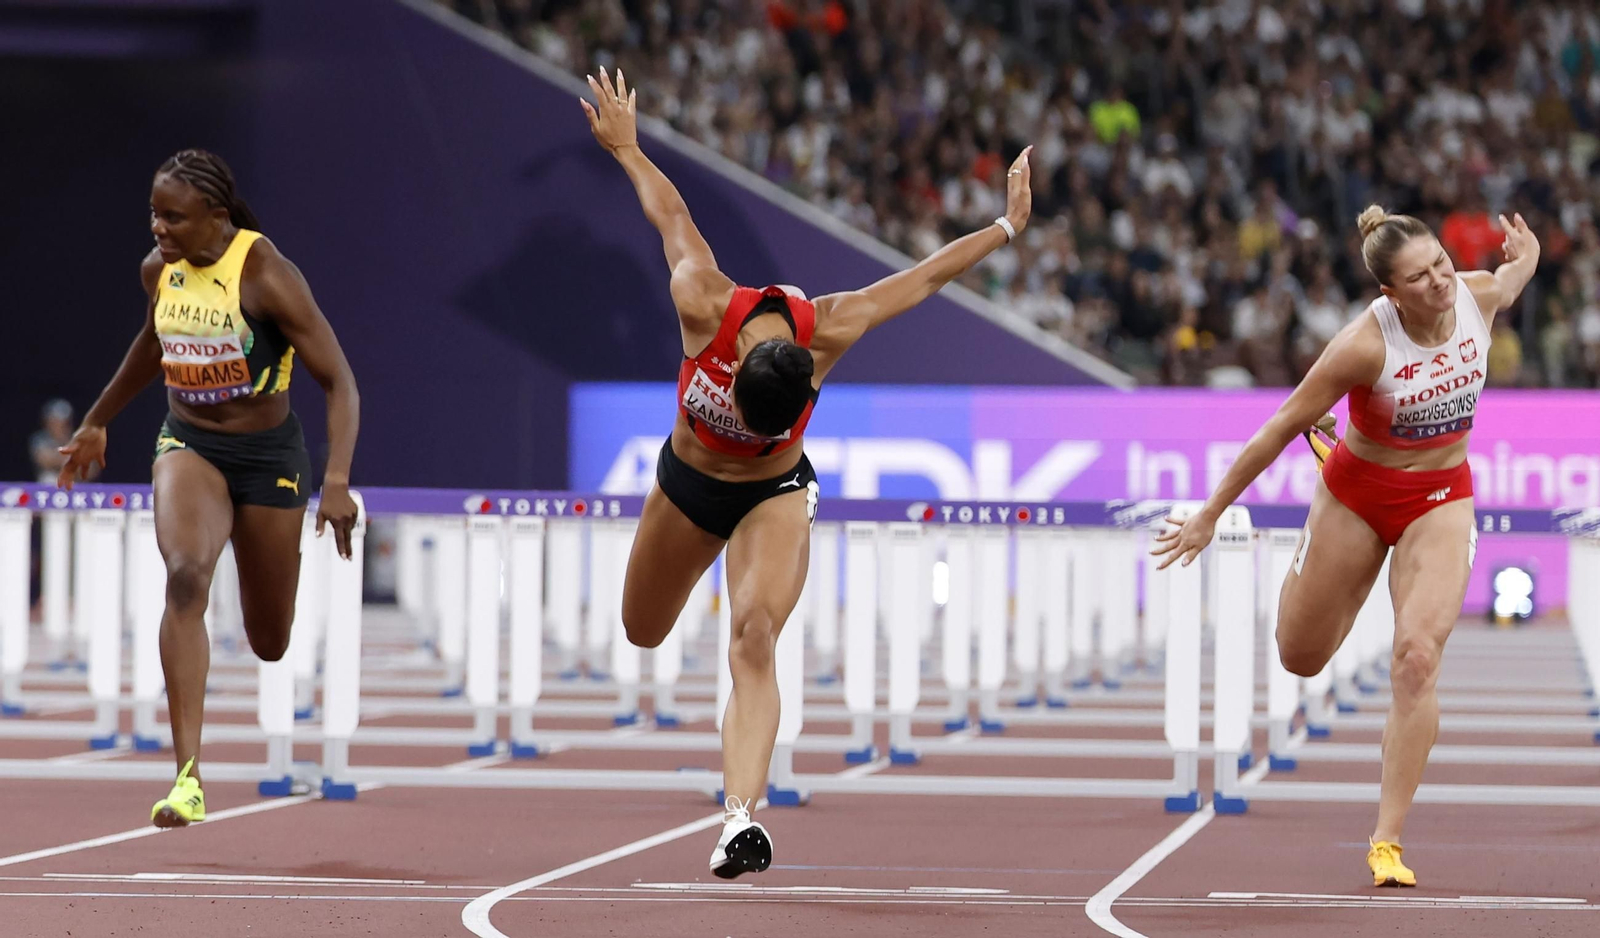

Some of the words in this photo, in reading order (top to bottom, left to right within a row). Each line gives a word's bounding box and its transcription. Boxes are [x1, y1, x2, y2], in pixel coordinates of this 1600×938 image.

[160, 303, 234, 331] JAMAICA
[163, 341, 238, 357] HONDA
[167, 362, 244, 387] WILLIAMS
[1430, 365, 1454, 379] ORLEN
[1398, 368, 1483, 407] HONDA
[687, 393, 751, 432] KAMBU
